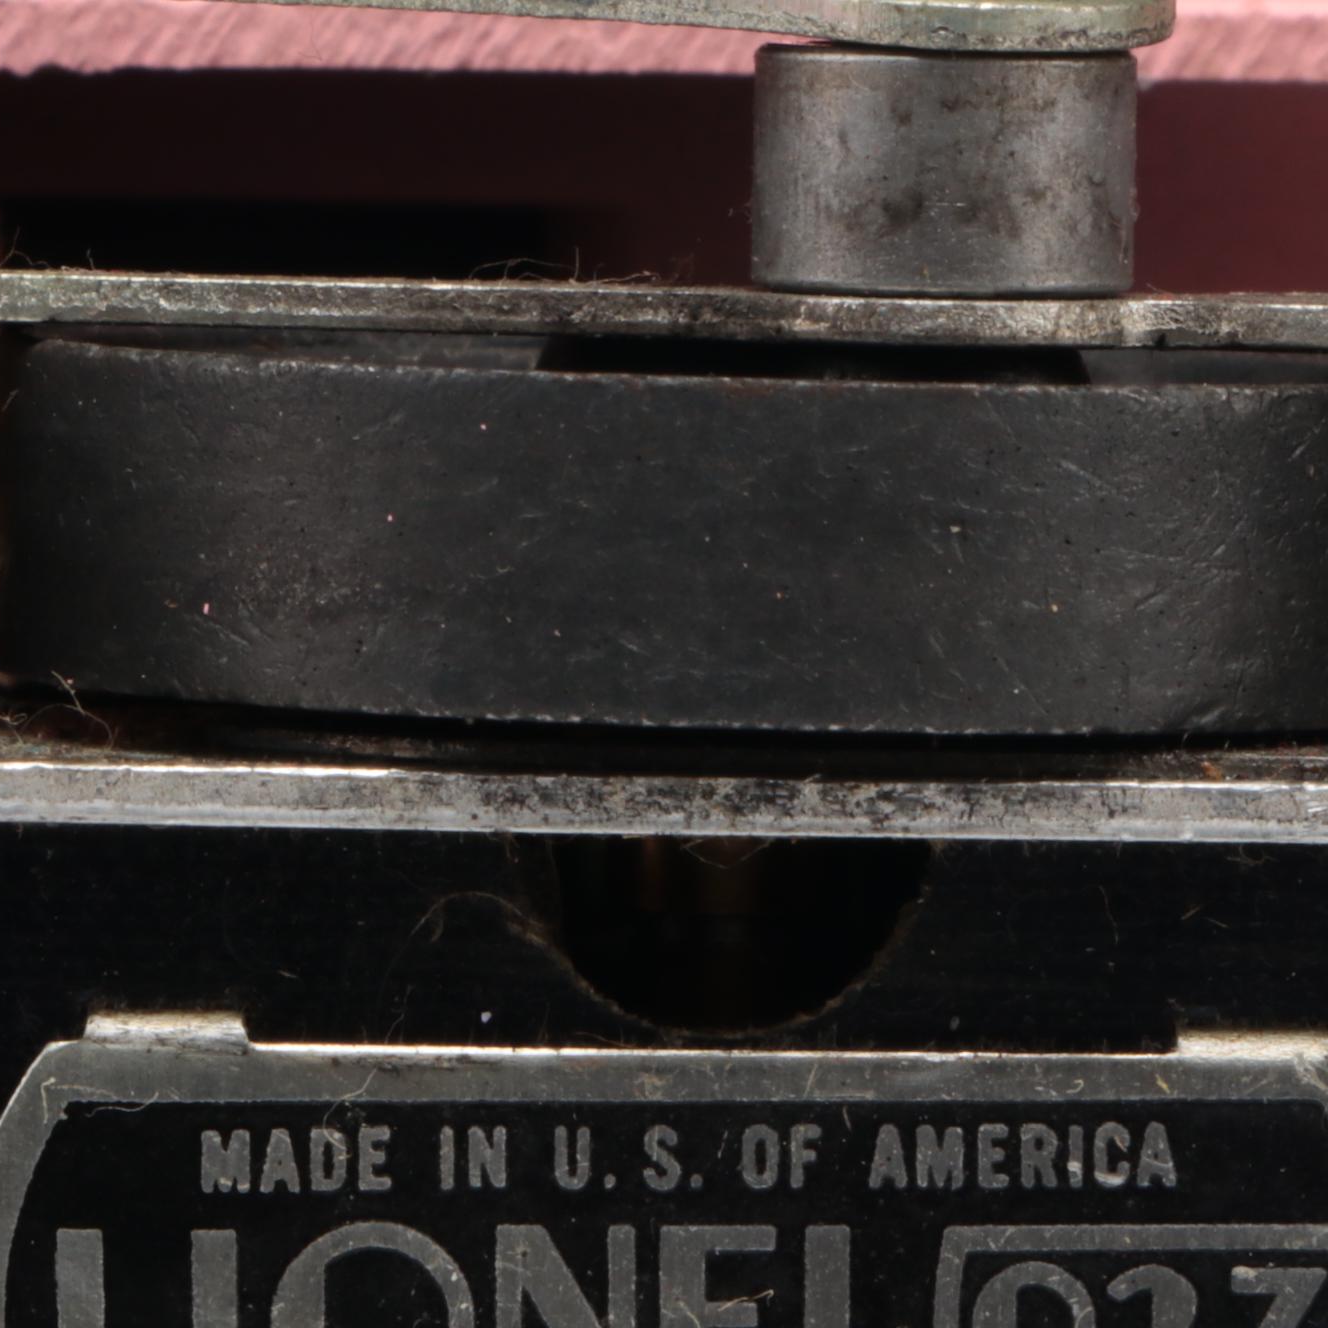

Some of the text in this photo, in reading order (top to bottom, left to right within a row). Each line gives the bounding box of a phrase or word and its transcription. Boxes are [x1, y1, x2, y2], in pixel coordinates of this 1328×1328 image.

[200, 1122, 394, 1194] MADE
[438, 1124, 509, 1192] IN
[741, 1122, 822, 1190] OF
[868, 1120, 1178, 1190] AMERICA
